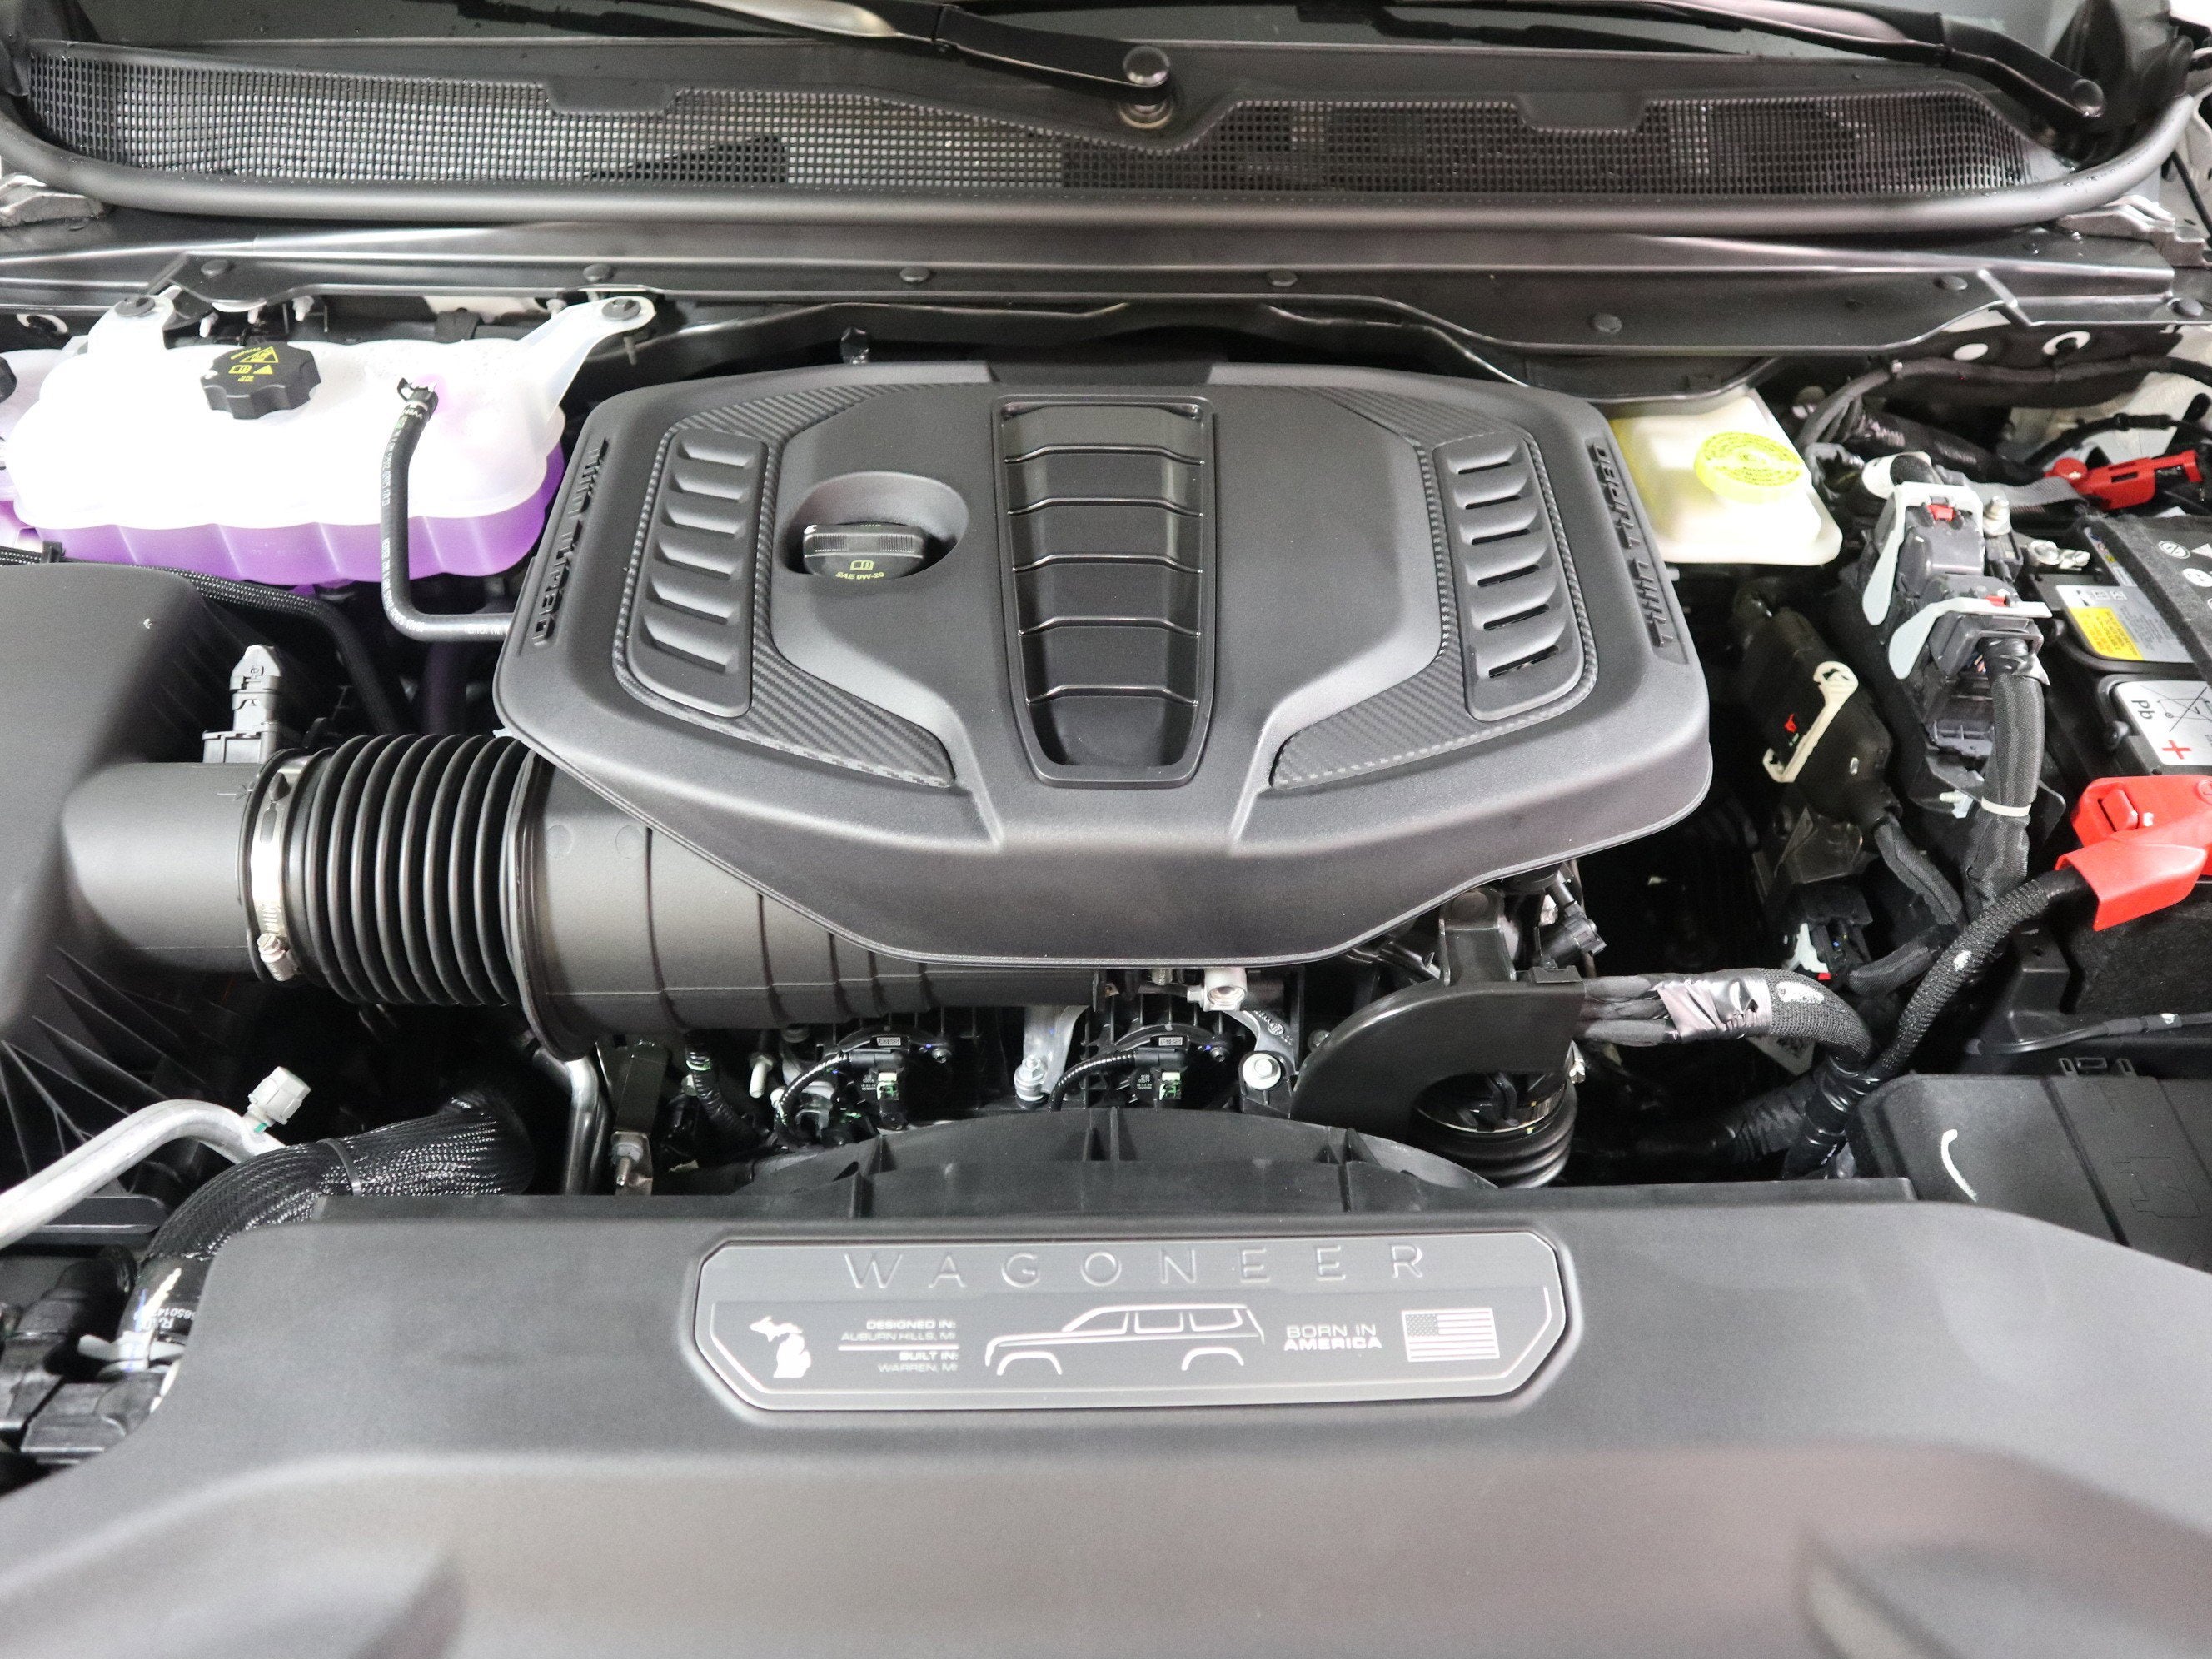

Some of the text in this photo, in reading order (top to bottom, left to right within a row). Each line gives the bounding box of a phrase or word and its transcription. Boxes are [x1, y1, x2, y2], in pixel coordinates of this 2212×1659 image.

[1587, 443, 1641, 550] TURBO
[531, 519, 584, 646] TURBO
[835, 571, 885, 580] SAE 0W-20
[2131, 700, 2155, 720] Pb
[844, 1243, 1423, 1288] WAGONEER
[866, 1319, 957, 1330] DESIGNED IN:
[1286, 1323, 1377, 1338] BORN IN
[840, 1332, 897, 1342] AUBURN
[939, 1332, 956, 1341] MI
[1283, 1336, 1382, 1351] AMERICA
[899, 1351, 959, 1361] BUILT IN:
[941, 1363, 959, 1372] MI
